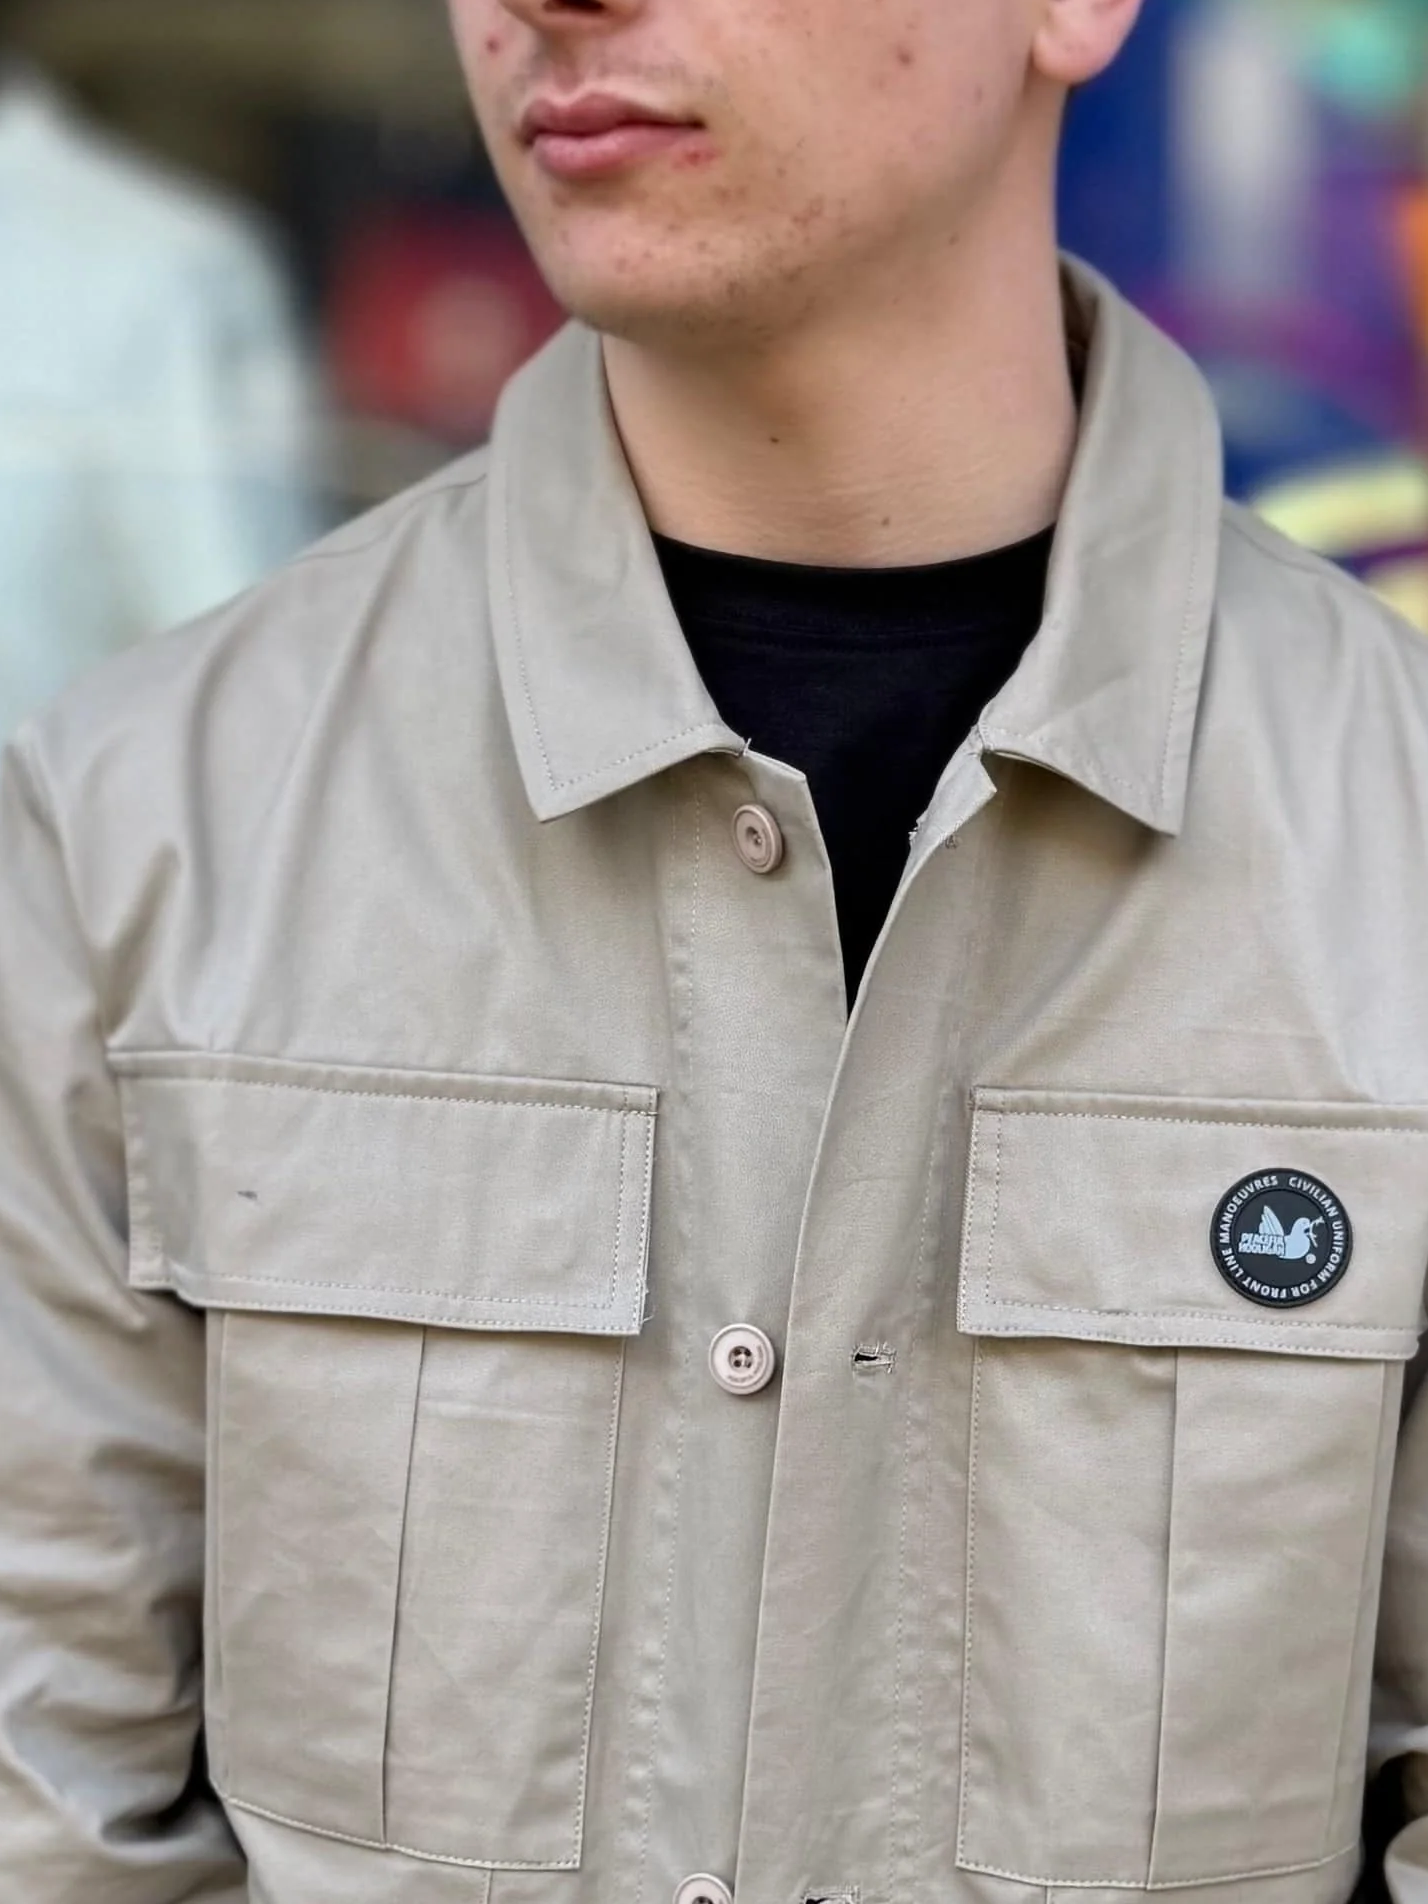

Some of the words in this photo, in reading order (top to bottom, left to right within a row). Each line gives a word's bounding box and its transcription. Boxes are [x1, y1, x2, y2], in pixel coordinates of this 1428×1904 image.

[1219, 1175, 1278, 1244] MANOEUVRES
[1288, 1176, 1338, 1217] CIVILIAN
[1222, 1247, 1244, 1277] LINE
[1318, 1221, 1345, 1283] UNIFORM
[1242, 1277, 1287, 1298] FRONT
[1291, 1280, 1318, 1297] FOR
